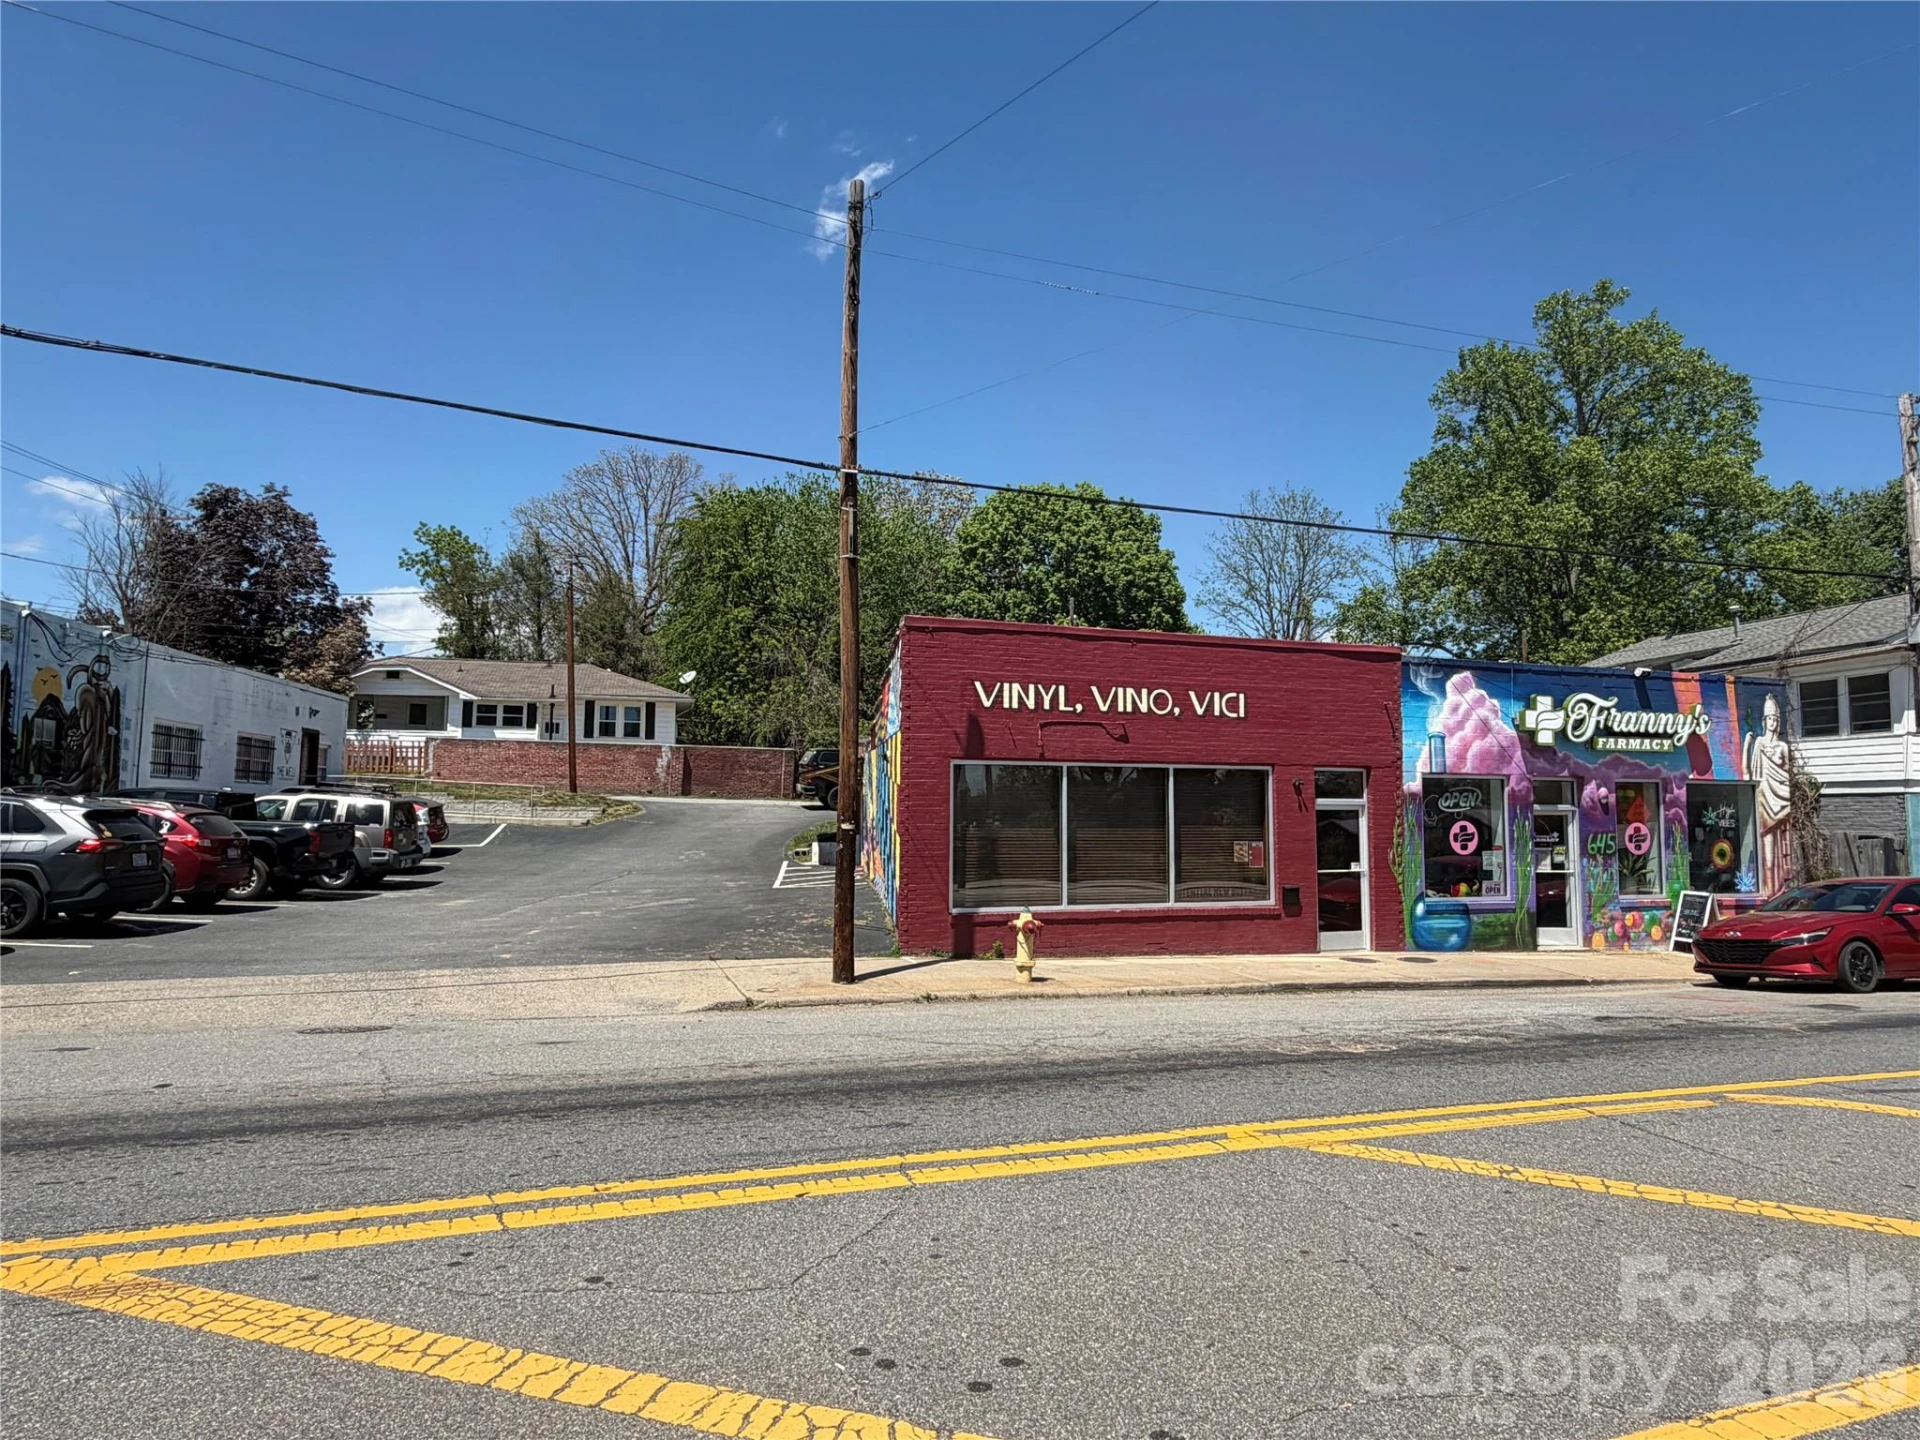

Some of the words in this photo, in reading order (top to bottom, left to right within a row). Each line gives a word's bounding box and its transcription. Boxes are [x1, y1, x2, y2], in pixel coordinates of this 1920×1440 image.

[973, 680, 1083, 713] VINYL,
[1090, 685, 1180, 716] VINO,
[1188, 690, 1246, 718] VICI
[1566, 692, 1711, 746] Franny's
[1597, 738, 1673, 750] FARMACY
[1441, 792, 1477, 807] OPEN
[1587, 833, 1616, 855] 645
[1485, 885, 1501, 894] OPEN
